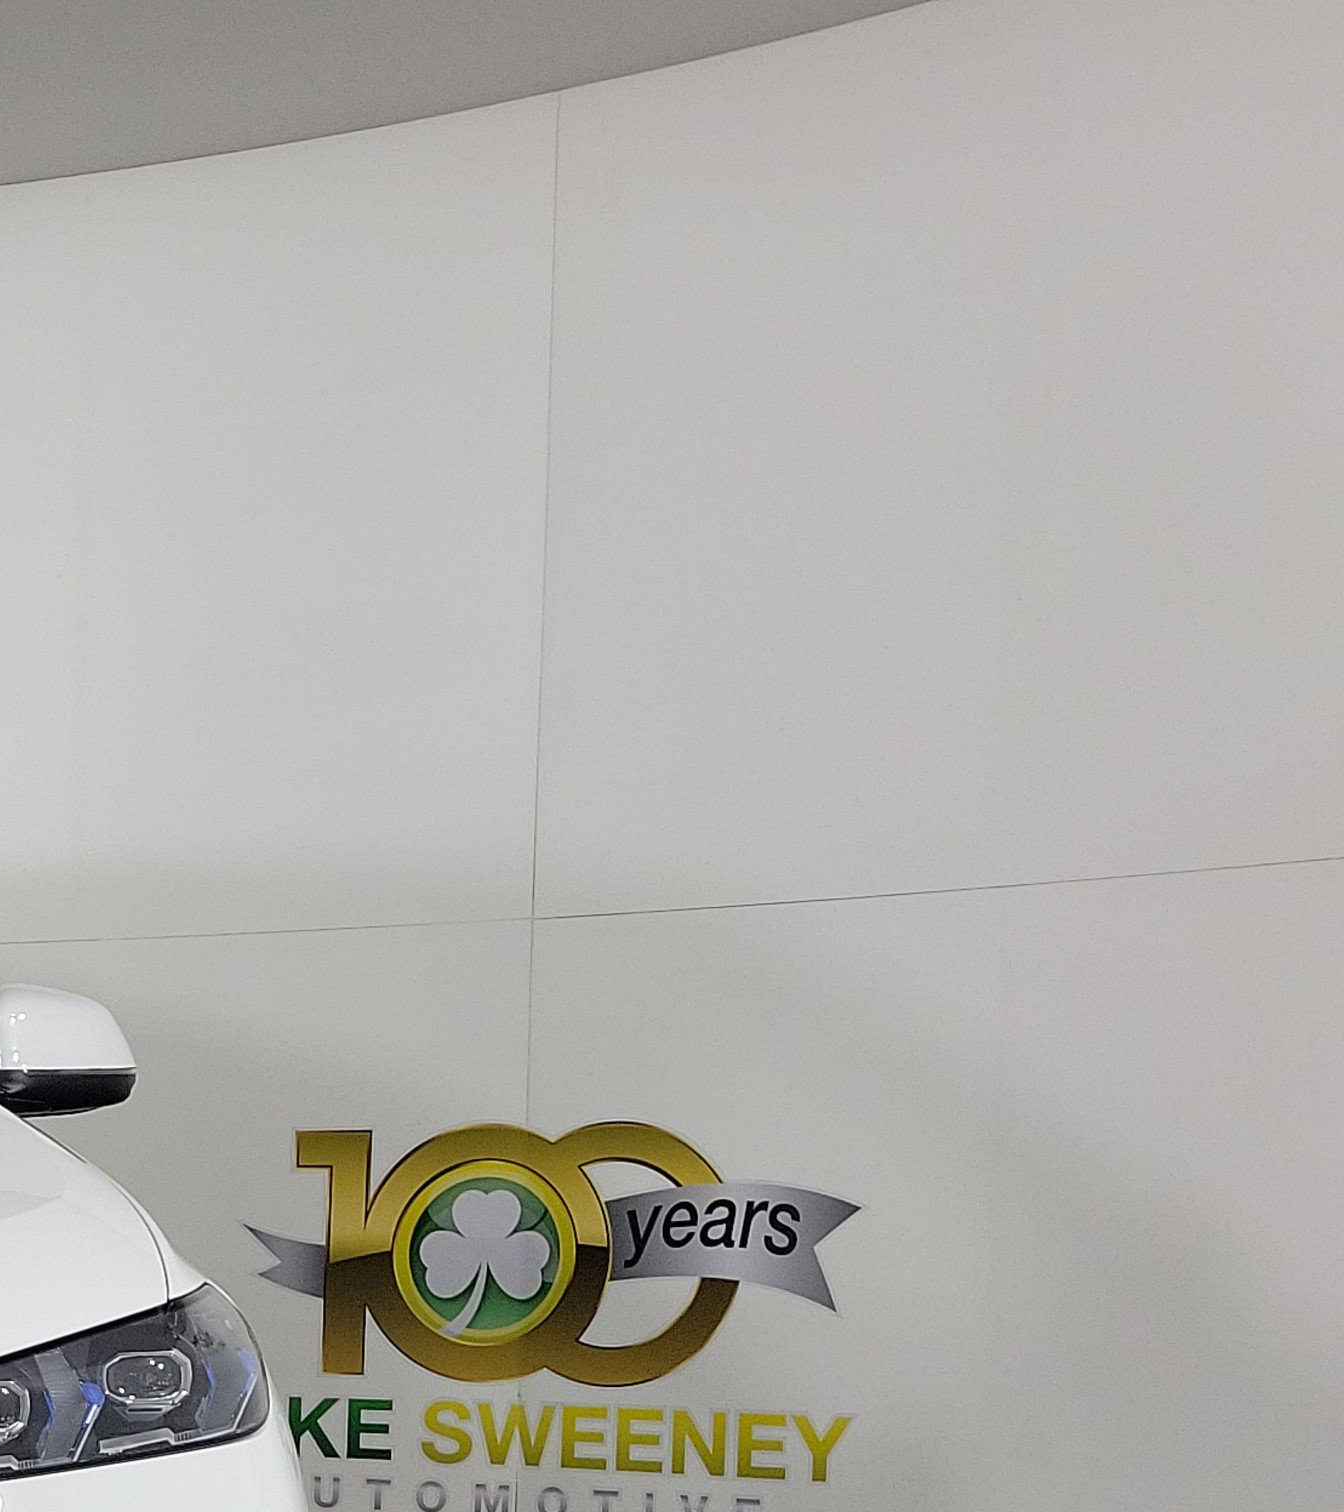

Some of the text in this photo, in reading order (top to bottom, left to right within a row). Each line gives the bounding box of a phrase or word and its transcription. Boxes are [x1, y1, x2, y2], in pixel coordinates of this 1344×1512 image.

[296, 1121, 738, 1387] 100
[624, 1198, 801, 1270] years
[288, 1397, 852, 1483] KE SWEENEY
